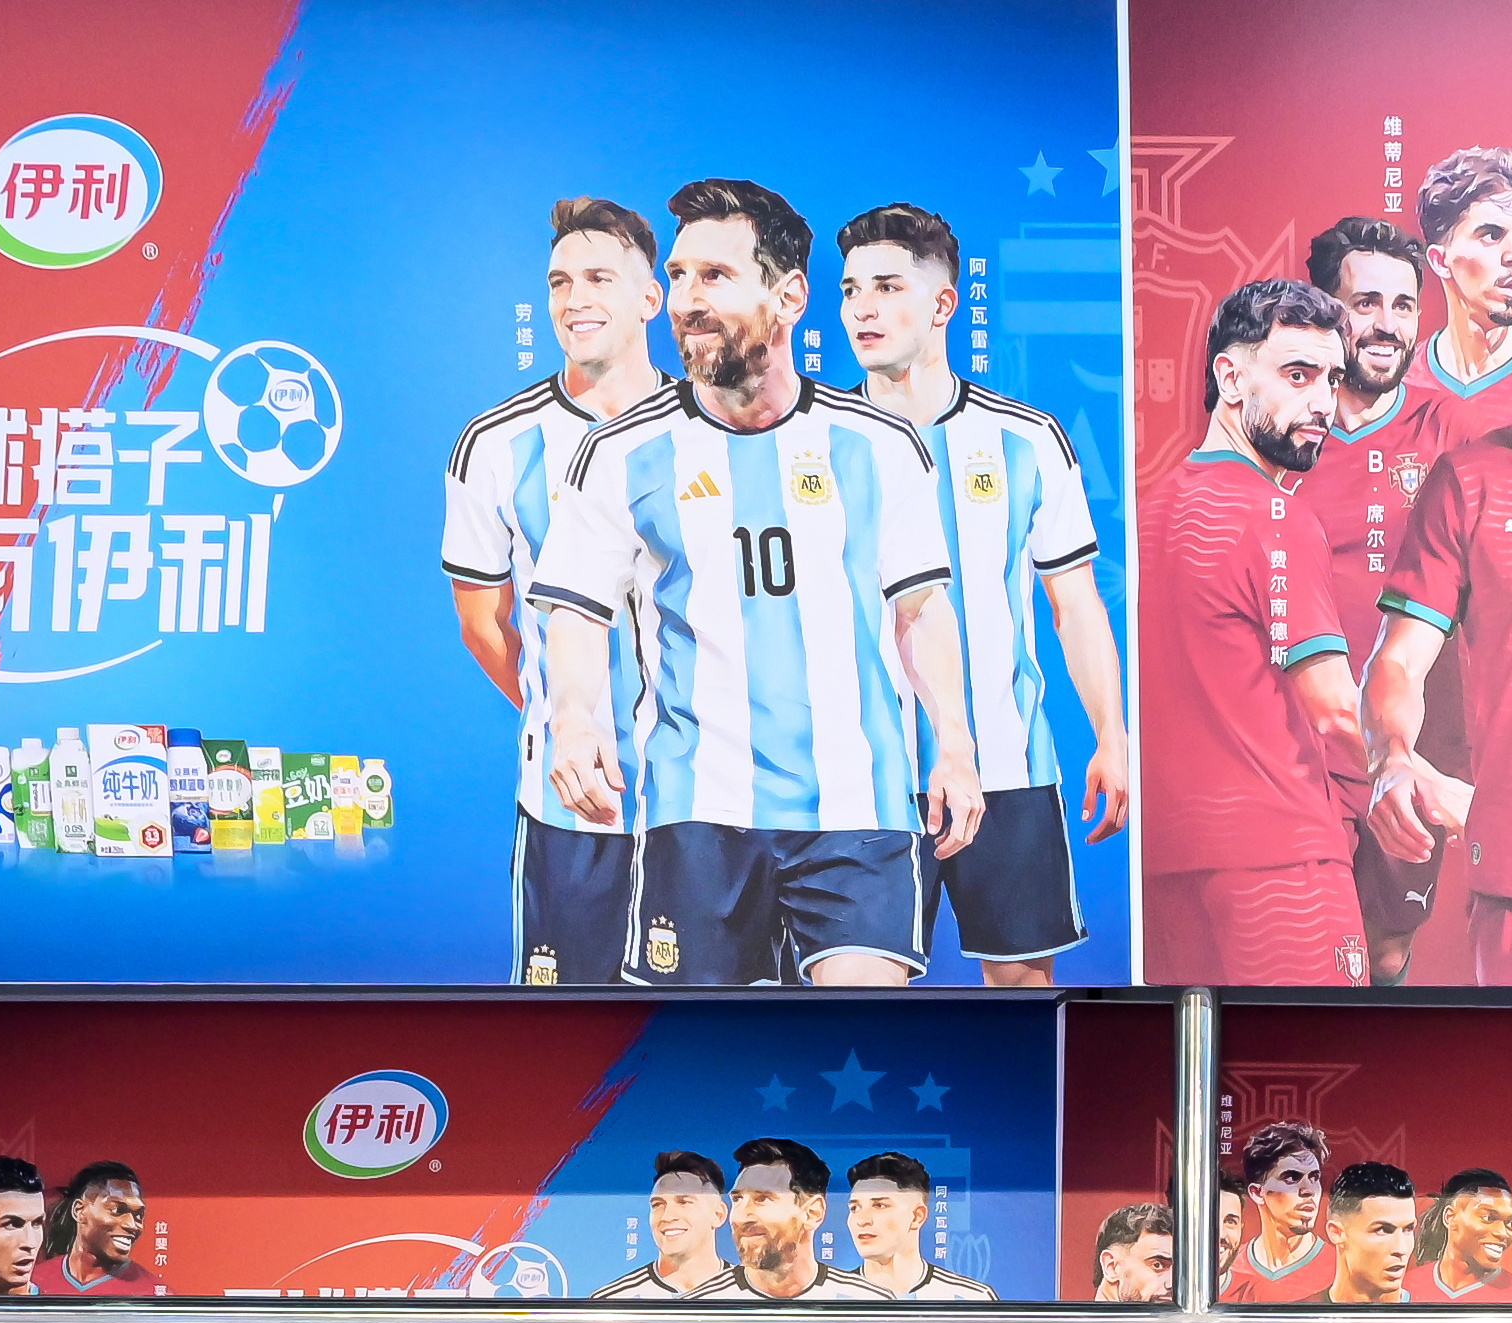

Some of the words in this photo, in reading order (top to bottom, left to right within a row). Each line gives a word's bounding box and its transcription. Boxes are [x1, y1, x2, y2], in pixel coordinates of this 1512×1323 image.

[0, 163, 133, 221] 伊利
[1383, 116, 1403, 214] 维蒂尼亚
[514, 303, 534, 372] 劳塔罗
[802, 328, 822, 373] 梅西
[968, 257, 989, 375] 阿尔瓦雷斯
[735, 526, 794, 598] 10
[100, 768, 161, 802] 纯牛奶
[322, 1102, 424, 1148] 伊利
[934, 1185, 949, 1260] 阿尔瓦雷斯
